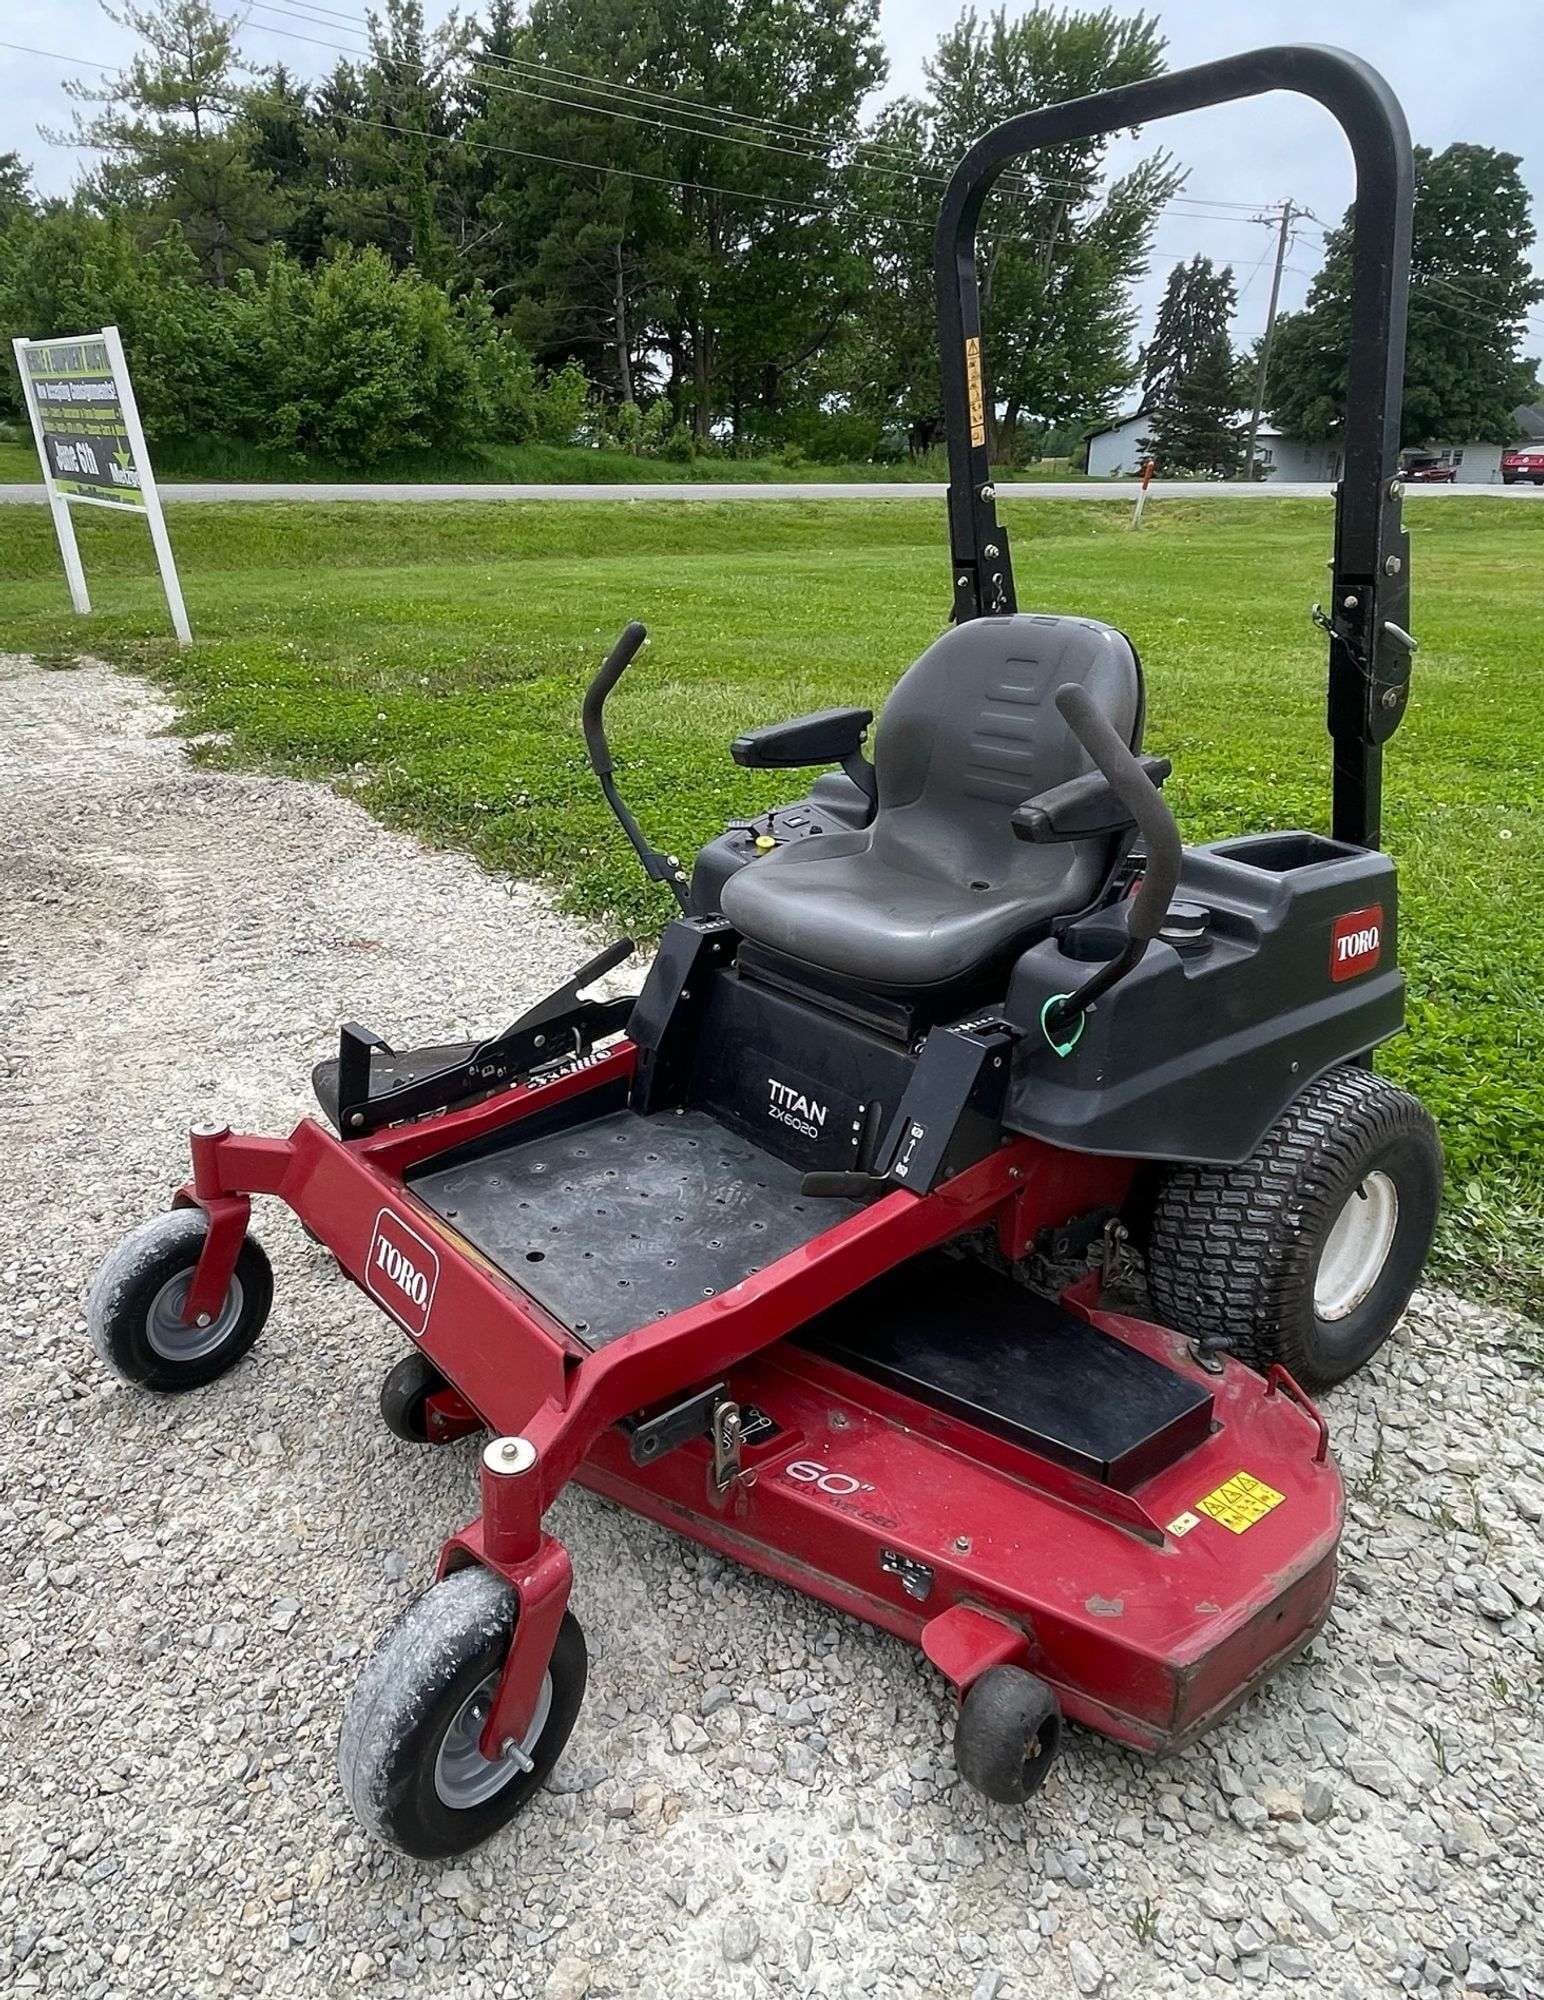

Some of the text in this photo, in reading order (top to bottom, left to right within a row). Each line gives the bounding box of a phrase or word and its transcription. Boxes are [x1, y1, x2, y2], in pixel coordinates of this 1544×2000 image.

[1337, 926, 1380, 962] TORO
[768, 1078, 827, 1126] TITAN
[768, 1104, 818, 1139] ZX6020
[375, 1234, 428, 1306] TORO
[785, 1460, 876, 1495] 60"
